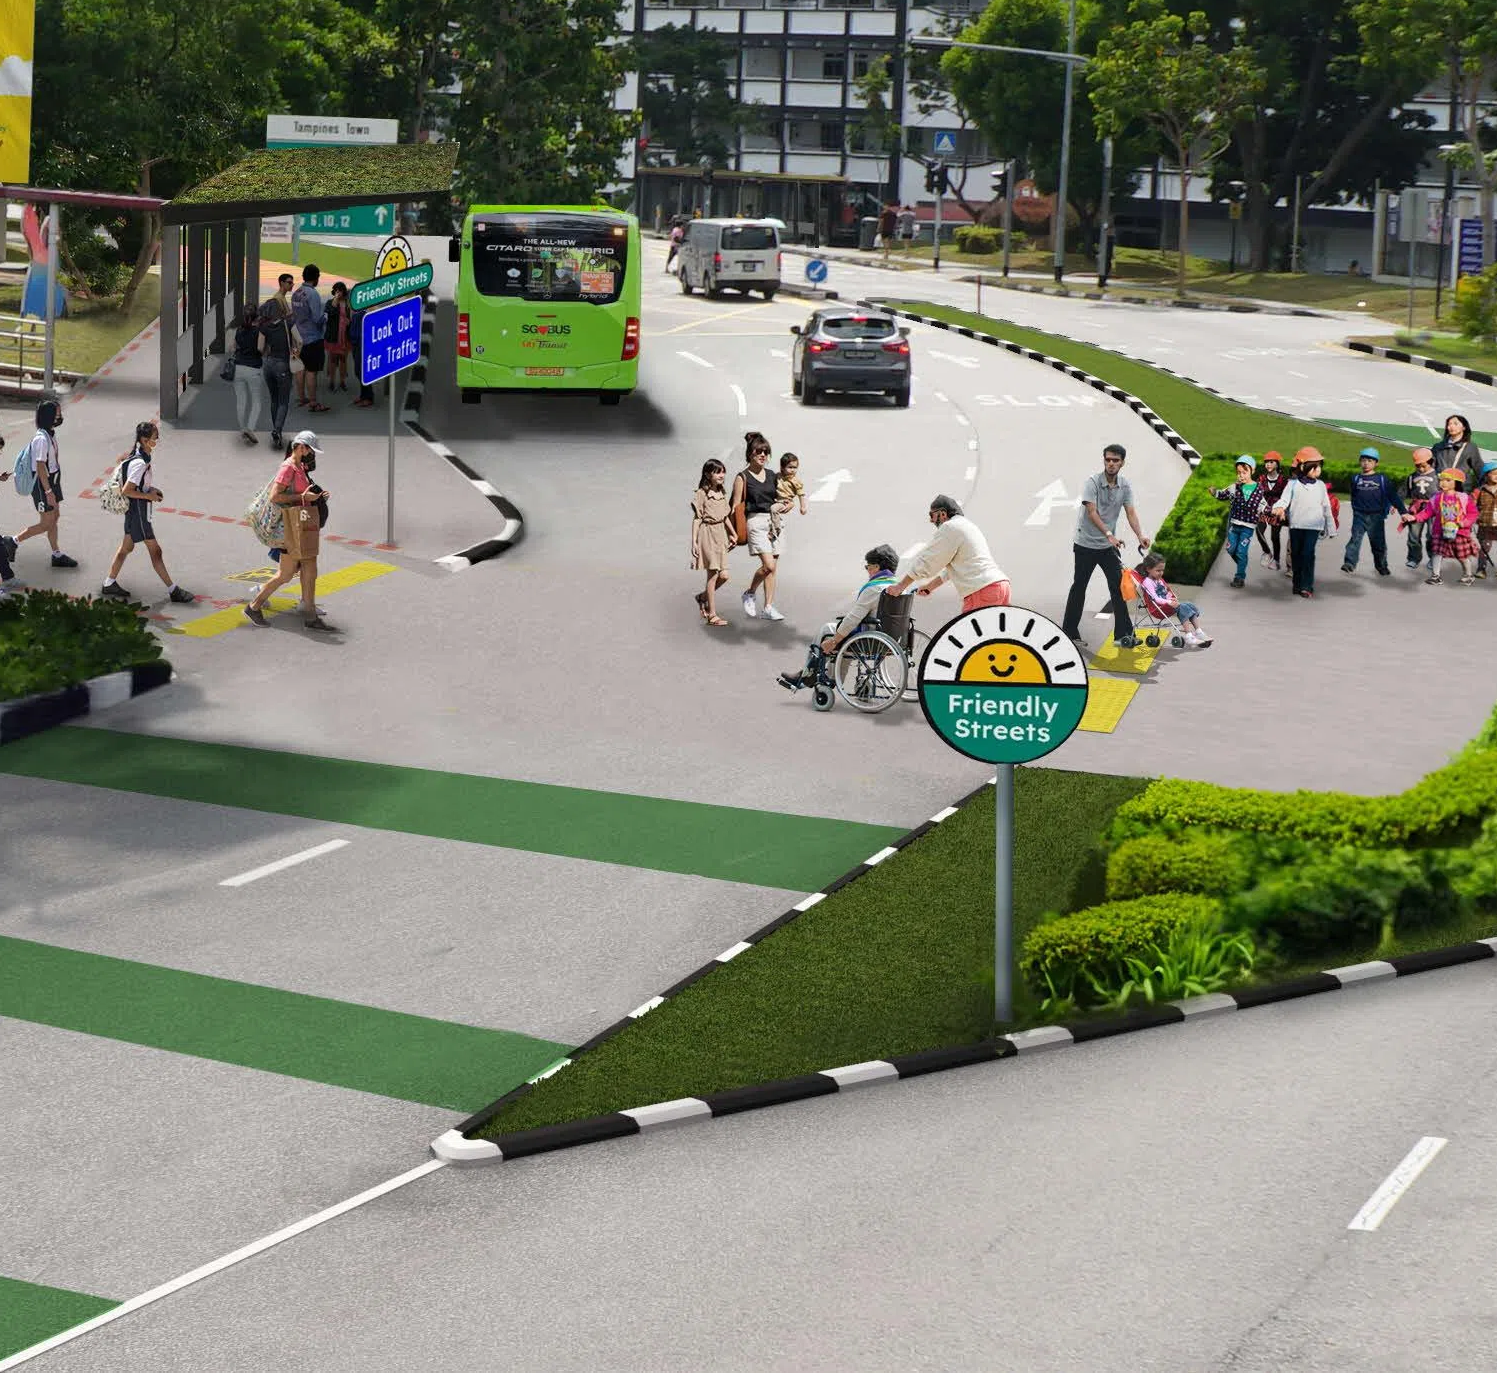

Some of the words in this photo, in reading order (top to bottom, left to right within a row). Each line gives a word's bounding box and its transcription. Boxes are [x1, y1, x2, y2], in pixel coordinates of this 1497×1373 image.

[293, 121, 339, 135] Tampines
[346, 123, 370, 135] Town
[340, 215, 351, 227] 12
[486, 244, 533, 252] CITARO
[539, 238, 577, 246] ALL-NEW
[356, 281, 395, 305] Friendly
[397, 271, 427, 291] Streets
[371, 319, 393, 343] Look
[397, 311, 414, 333] Out
[367, 354, 382, 373] for
[387, 339, 417, 364] Traffic
[974, 394, 1100, 408] SLOW
[948, 692, 1059, 724] Friendly
[954, 718, 1051, 743] Streets
